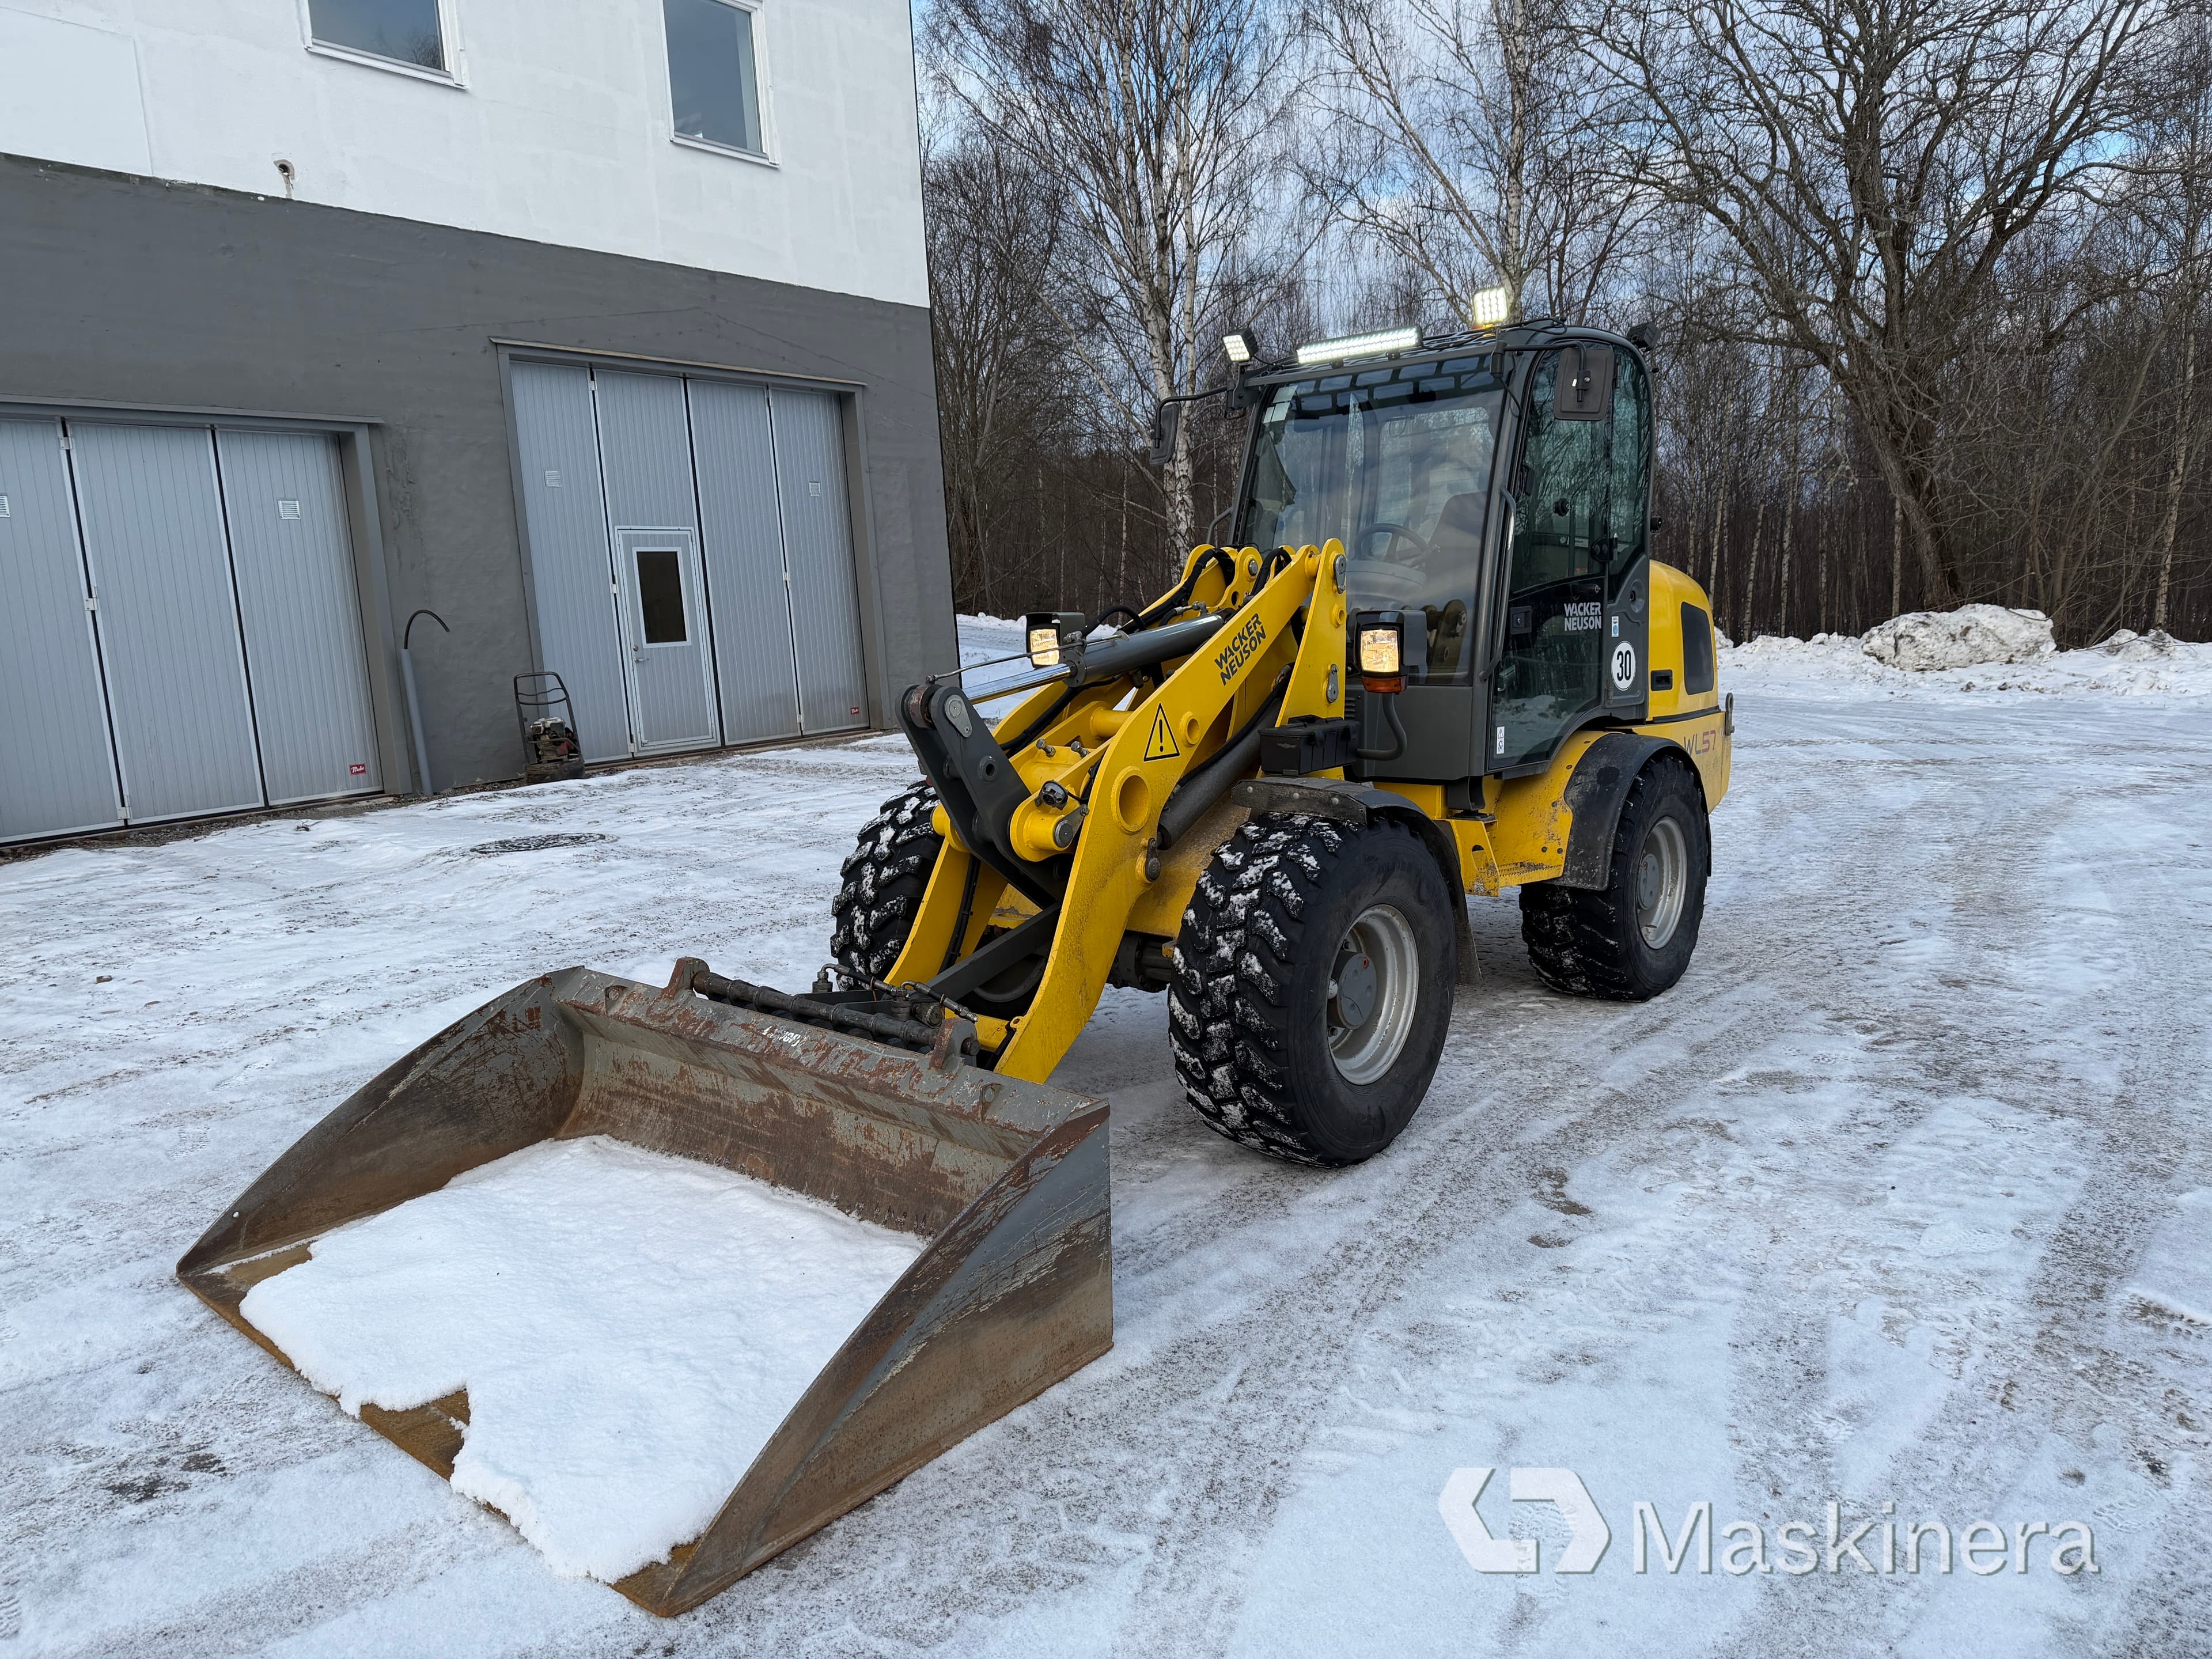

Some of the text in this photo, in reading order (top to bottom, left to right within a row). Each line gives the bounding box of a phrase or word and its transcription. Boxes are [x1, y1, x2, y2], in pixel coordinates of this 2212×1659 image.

[1563, 602, 1601, 616] WACKER
[1565, 616, 1601, 631] NEUSON
[1214, 613, 1262, 669] WACKER
[1220, 626, 1266, 686] NEUSON
[1616, 650, 1631, 681] 30
[1683, 729, 1716, 756] WL57
